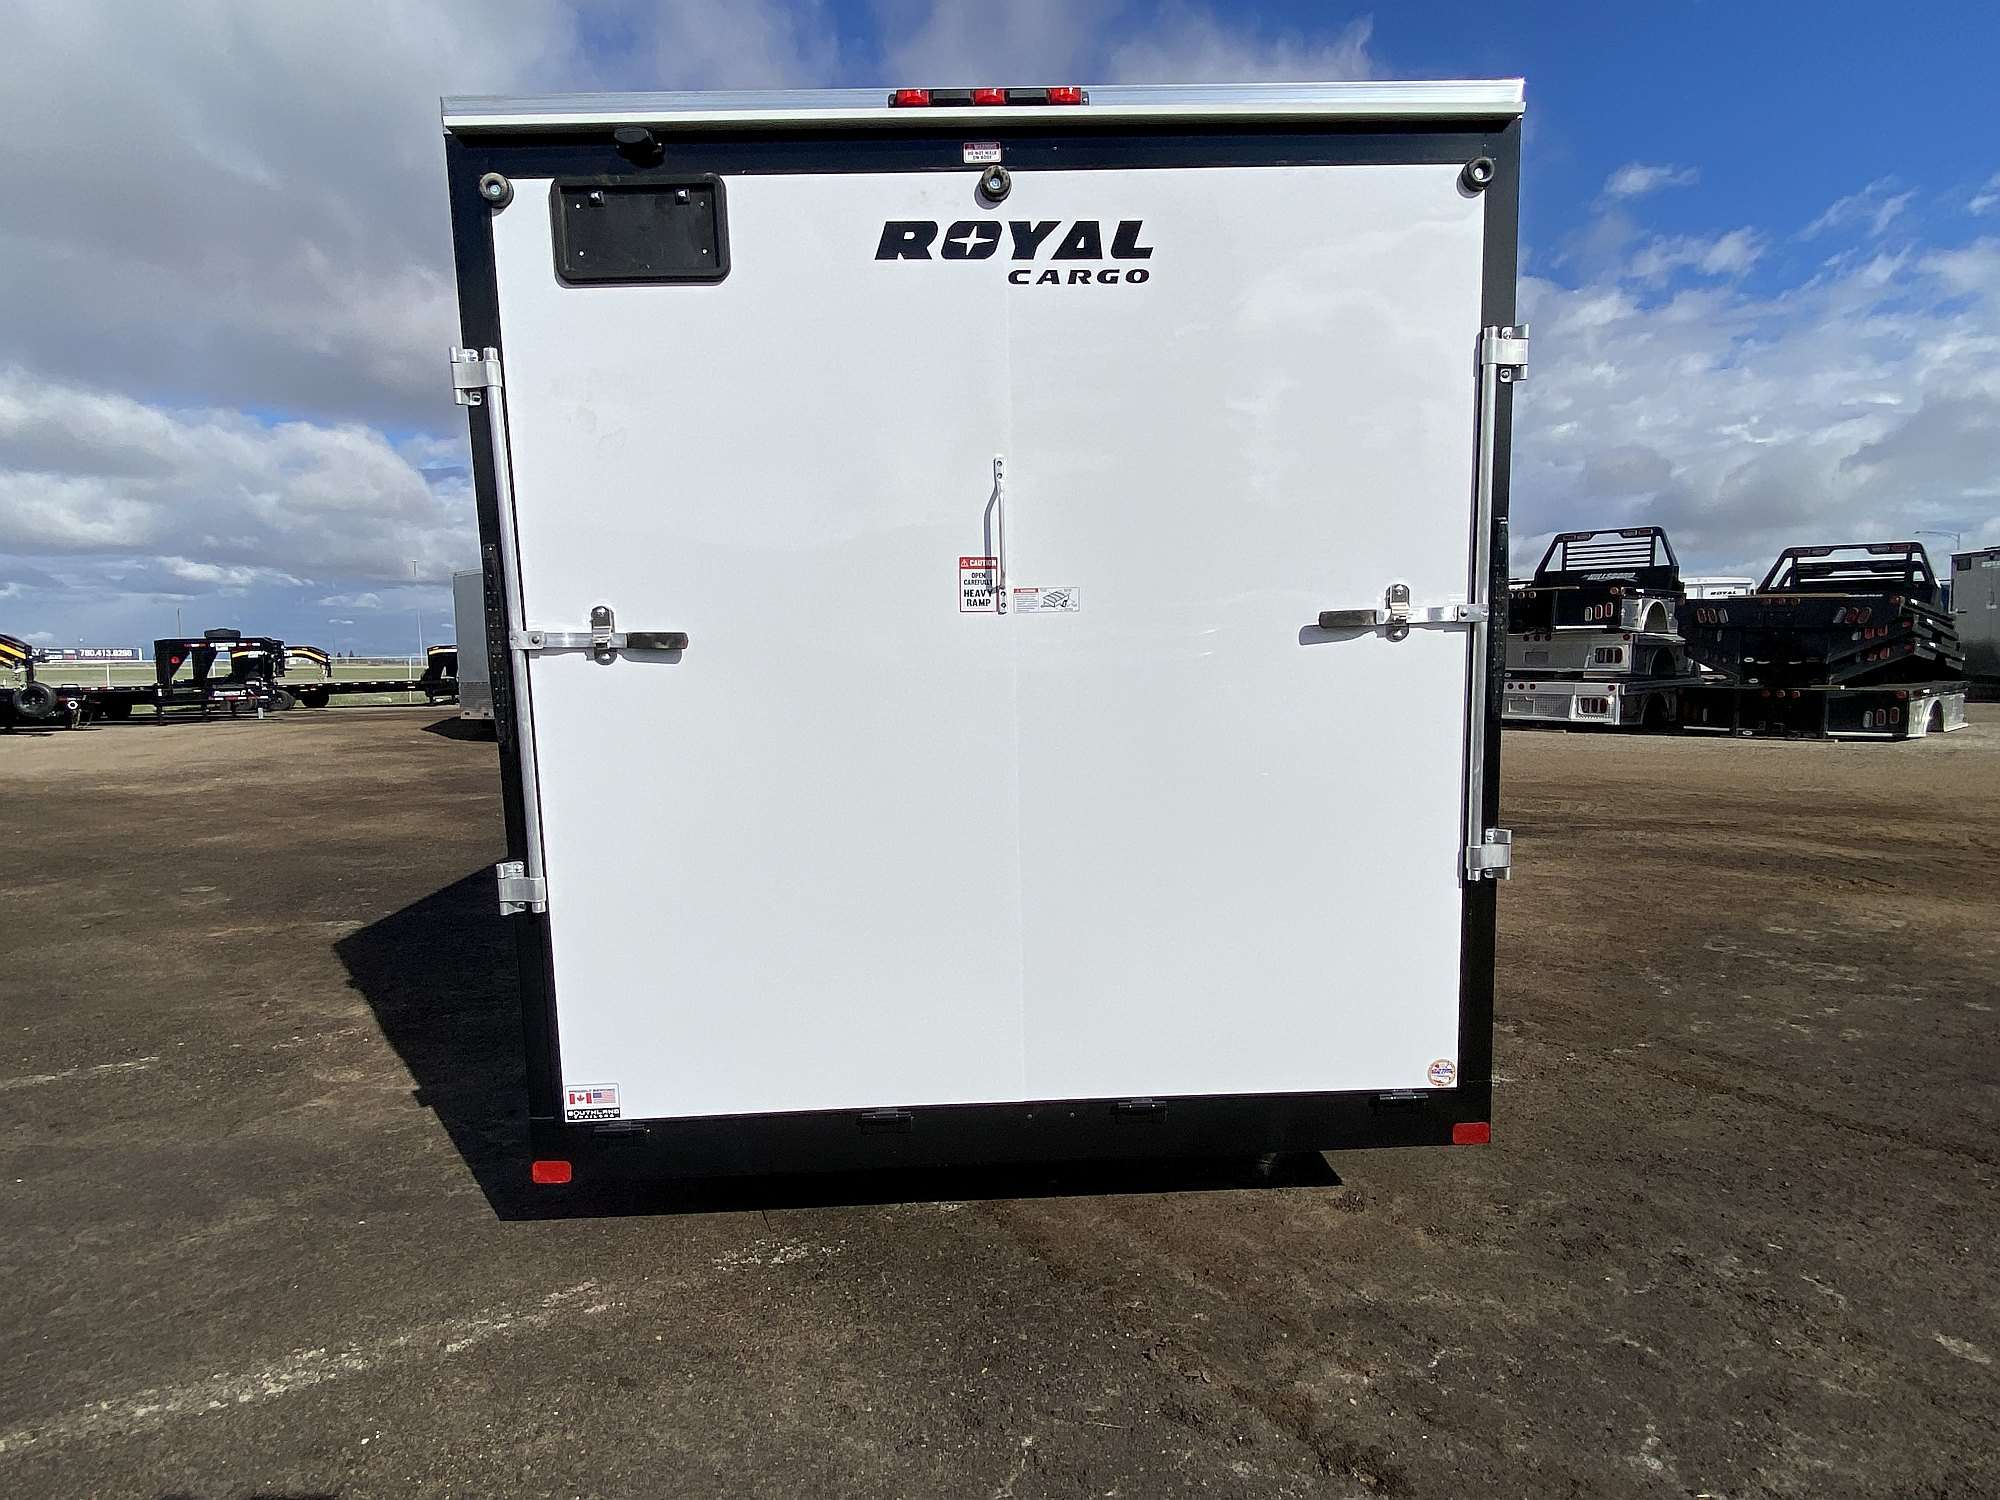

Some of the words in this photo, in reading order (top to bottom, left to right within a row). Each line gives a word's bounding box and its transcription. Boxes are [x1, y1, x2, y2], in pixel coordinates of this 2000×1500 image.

[874, 220, 1154, 260] ROYAL
[1008, 268, 1150, 285] CARGO
[963, 589, 993, 597] HEAVY
[966, 598, 991, 607] RAMP
[567, 1109, 620, 1117] SOUTHLAND
